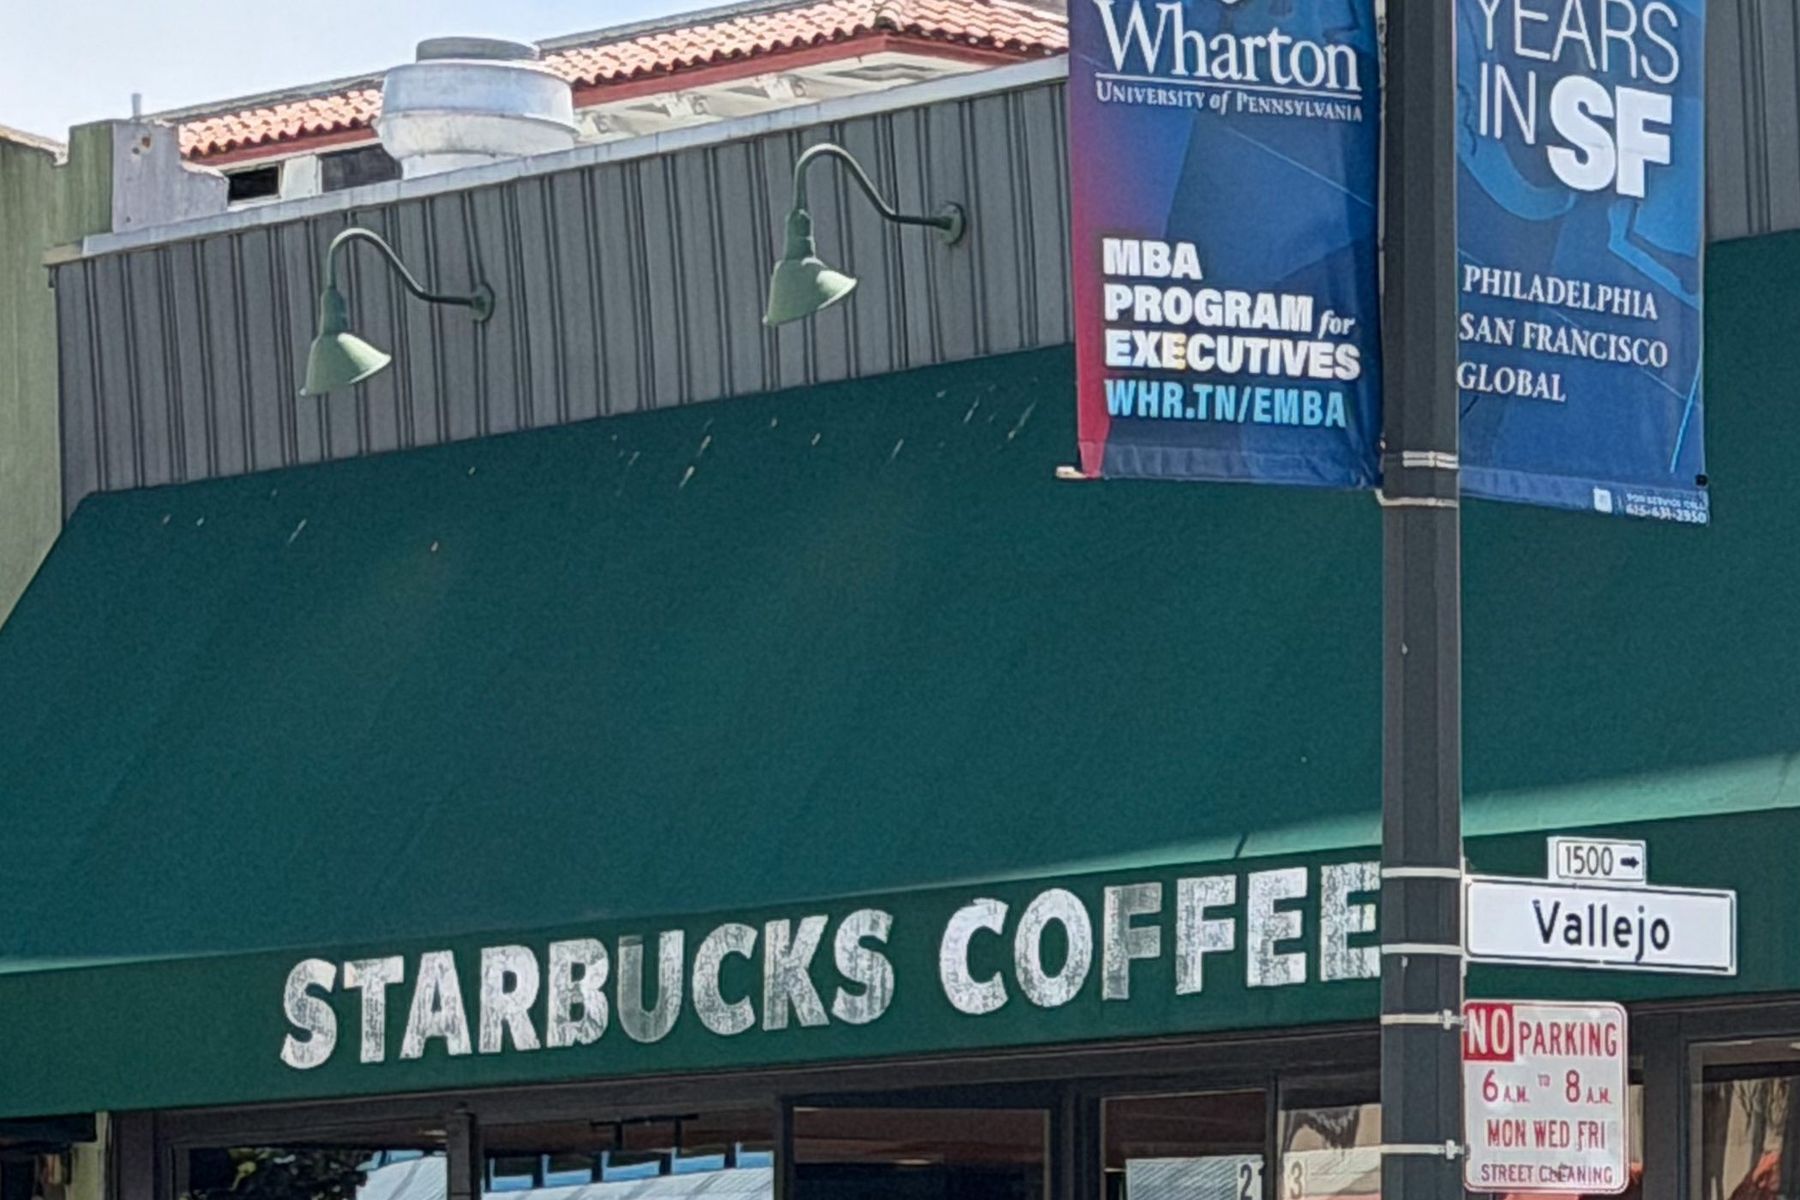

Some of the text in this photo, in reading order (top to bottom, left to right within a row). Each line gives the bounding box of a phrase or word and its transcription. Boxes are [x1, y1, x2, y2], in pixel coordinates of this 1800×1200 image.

[1095, 0, 1362, 91] Wharton
[1475, 0, 1679, 85] YEARS
[1096, 80, 1362, 122] UNIVERSITY of PENNSYLVANIA
[1479, 61, 1673, 198] IN SF
[1103, 237, 1202, 280] MBA
[1104, 283, 1355, 337] PROGRAM for
[1463, 264, 1659, 321] PHILADELPHIA
[1104, 330, 1361, 380] EXECUTIVES
[1459, 313, 1669, 368] SAN FRANCISCO
[1105, 379, 1346, 427] WHR.TN/EMBA
[1456, 362, 1566, 402] GLOBAL
[1565, 845, 1614, 876] 1500
[1532, 899, 1671, 963] Vallejo
[279, 860, 1382, 1071] STARBUCKS COFFEE
[1467, 1008, 1618, 1058] NO PARKING
[1482, 1069, 1499, 1103] 6
[1565, 1069, 1582, 1103] 8
[1487, 1119, 1606, 1151] MON WED FRI
[1481, 1164, 1613, 1185] STREET CLEANING
